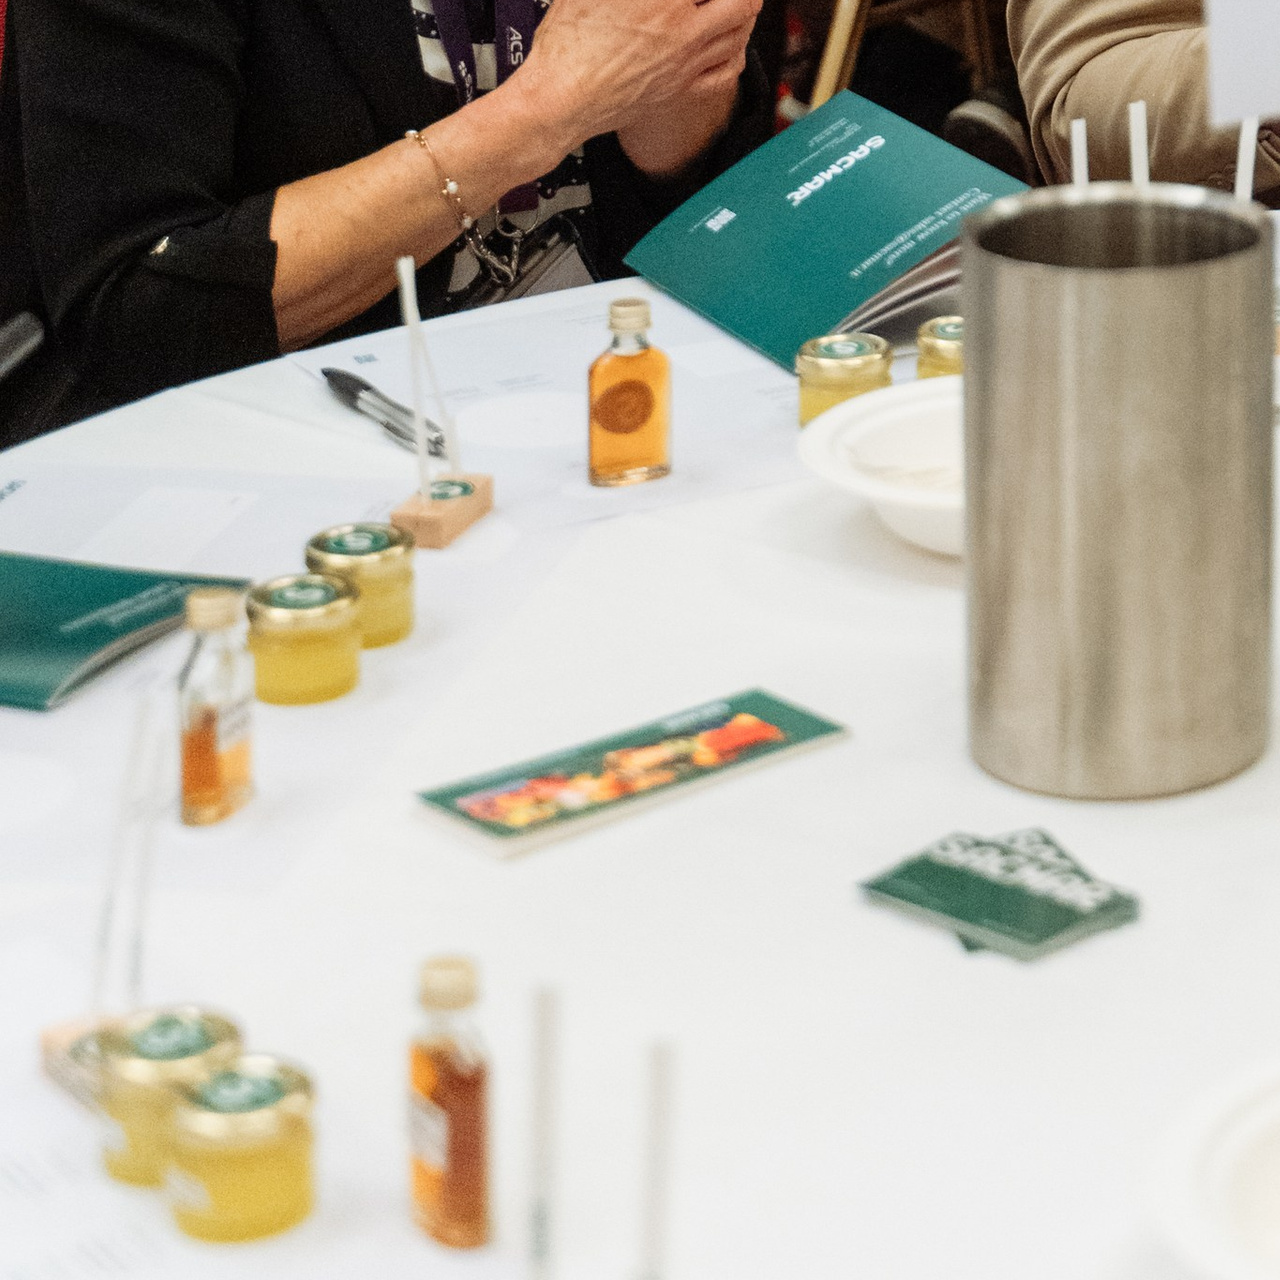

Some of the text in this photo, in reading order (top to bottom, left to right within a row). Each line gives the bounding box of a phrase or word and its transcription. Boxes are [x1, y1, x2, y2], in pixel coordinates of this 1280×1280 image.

[509, 26, 524, 66] ACS
[786, 135, 886, 207] SACMAR
[934, 187, 981, 217] Contact
[917, 219, 949, 241] know
